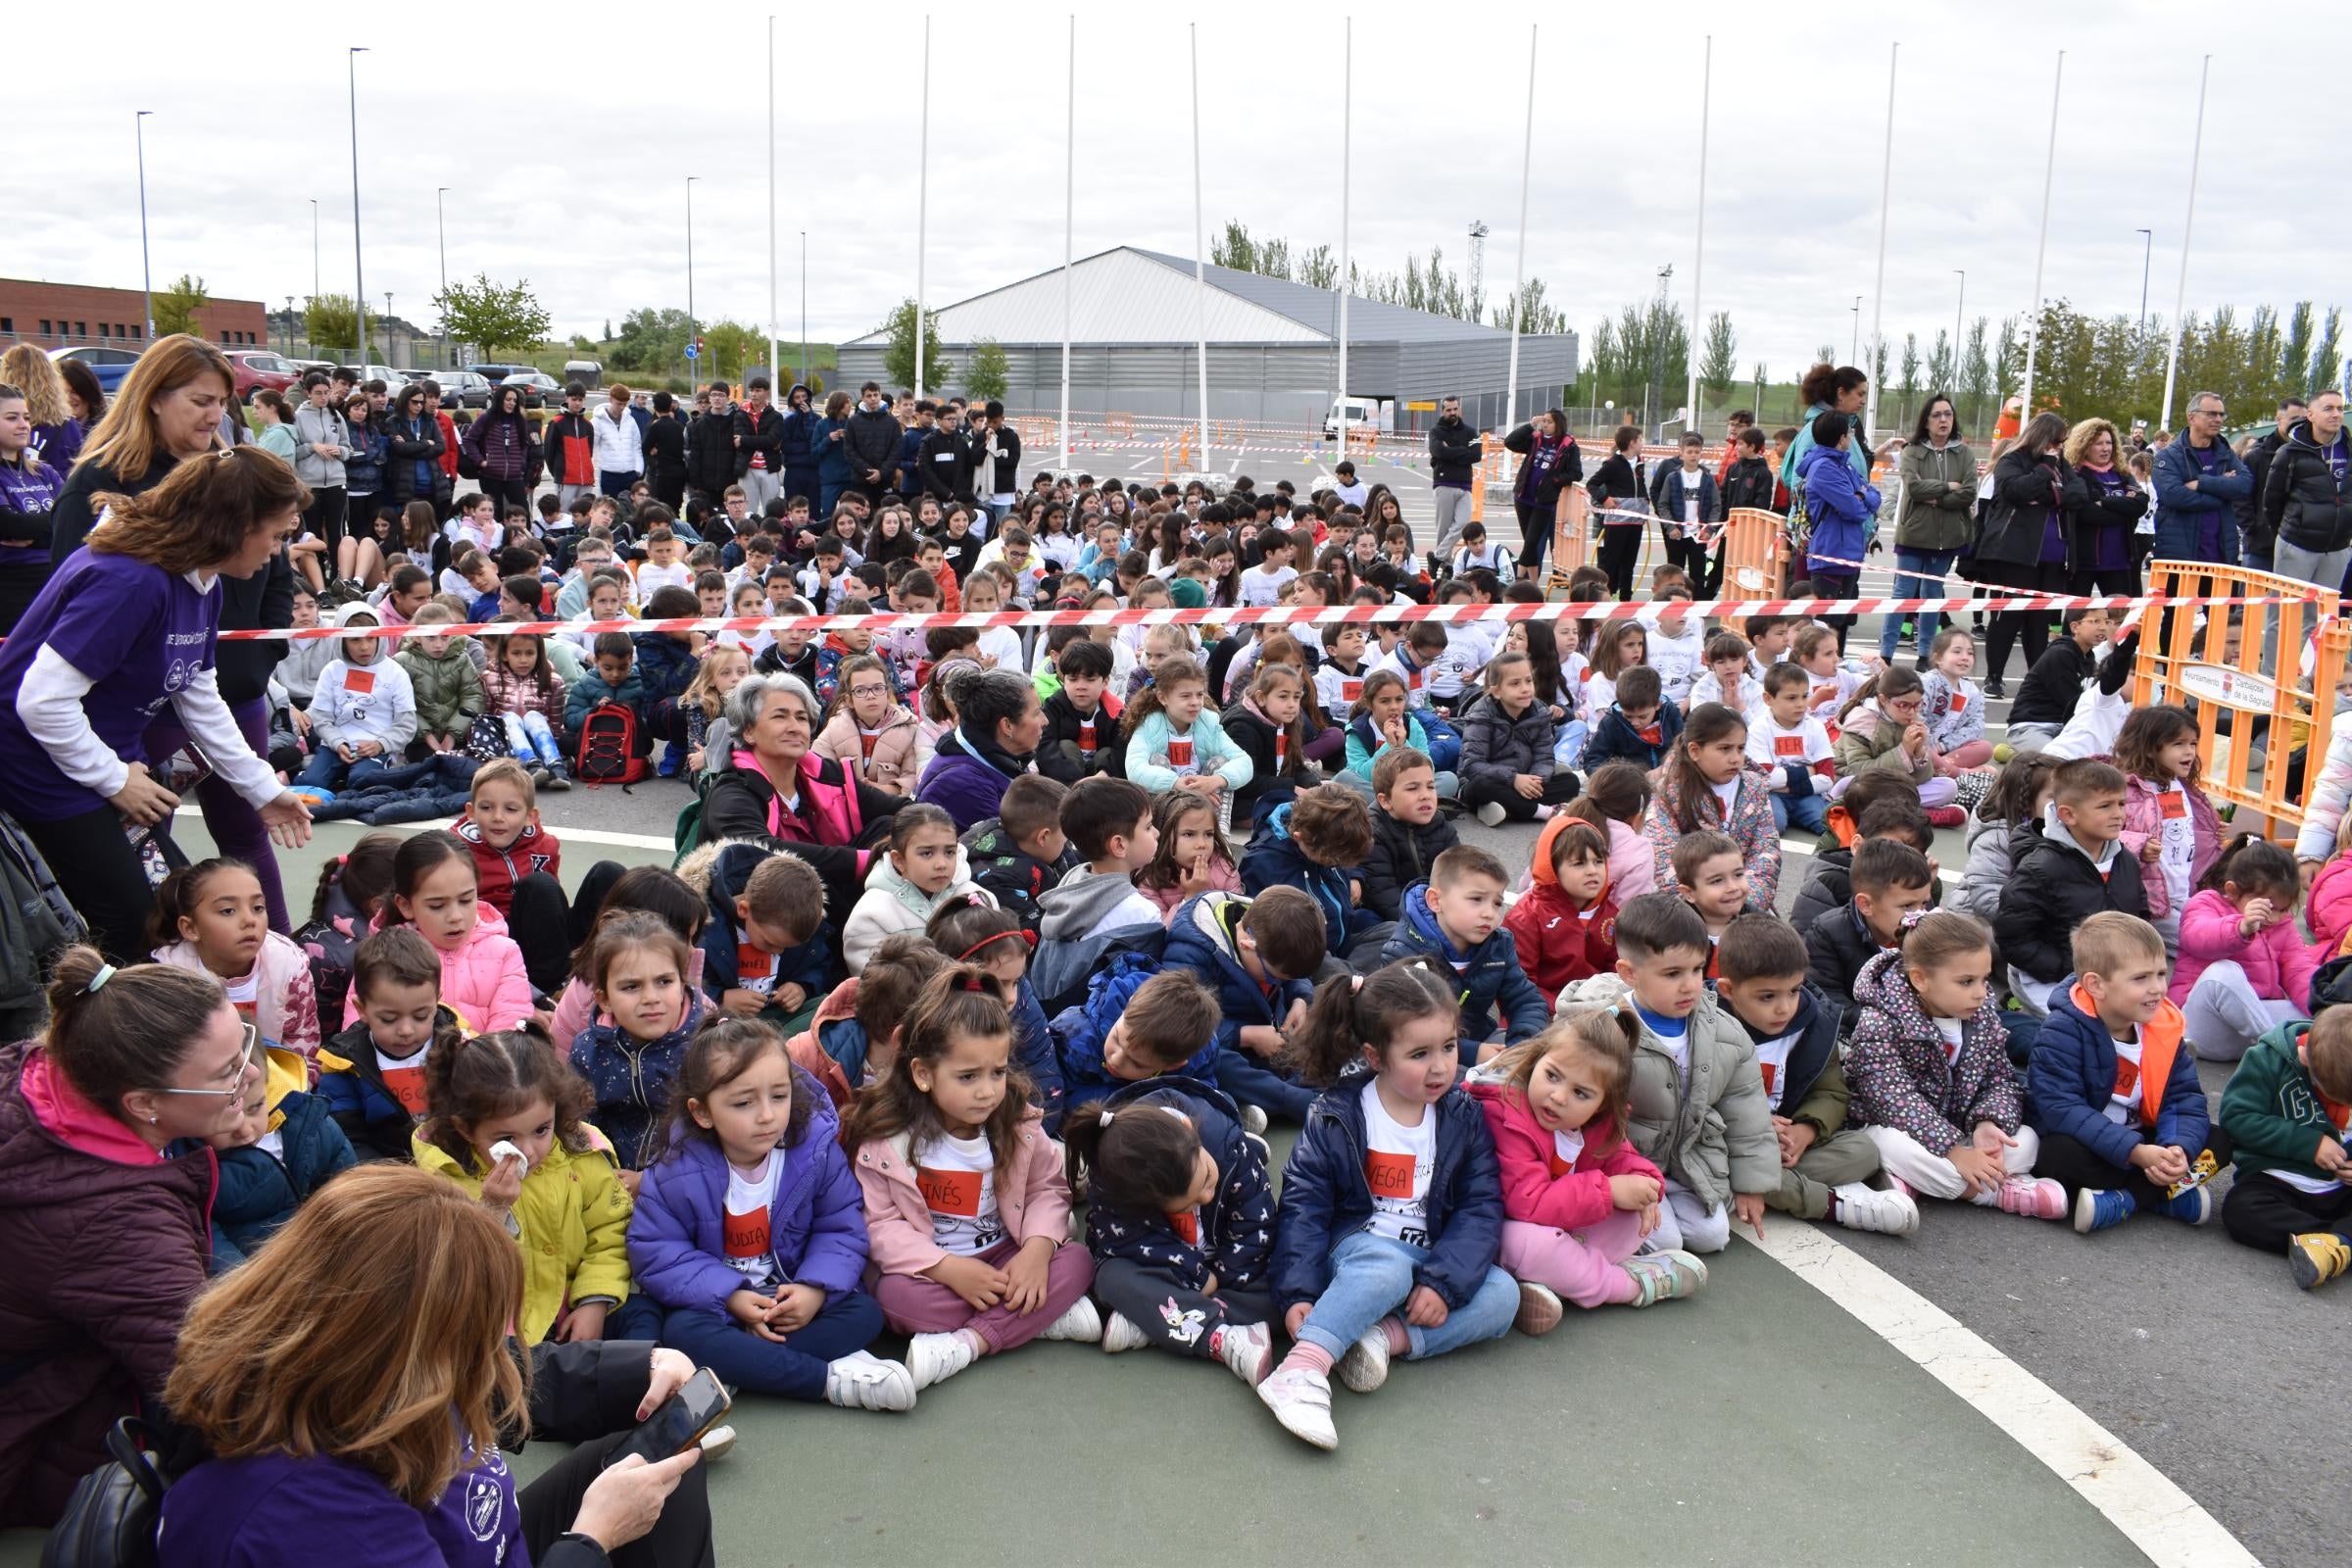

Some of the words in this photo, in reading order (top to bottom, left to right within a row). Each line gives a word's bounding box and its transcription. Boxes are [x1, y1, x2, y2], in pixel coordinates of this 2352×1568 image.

[2183, 669, 2221, 687] Ayuntamiento
[2235, 678, 2264, 695] Carbajosa
[2234, 692, 2242, 702] de
[1367, 1163, 1407, 1190] VEGA
[924, 1180, 962, 1207] INÉS
